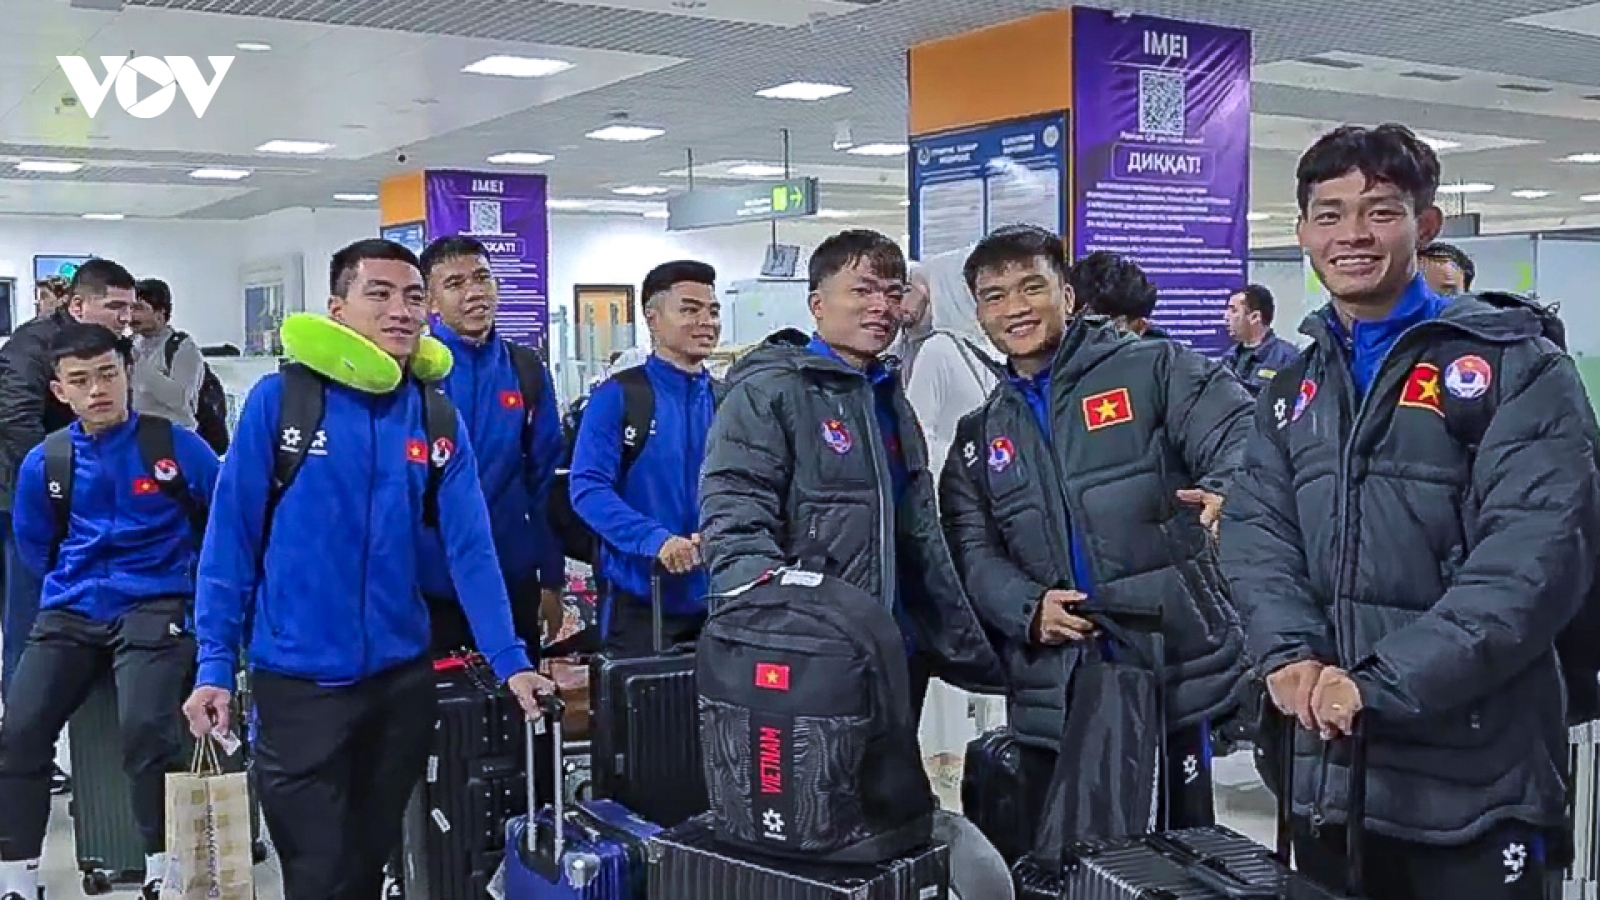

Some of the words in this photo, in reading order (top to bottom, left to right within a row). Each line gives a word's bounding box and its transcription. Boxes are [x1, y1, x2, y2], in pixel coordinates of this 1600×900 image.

[1143, 30, 1188, 59] IMEI
[472, 180, 504, 194] IMEI
[759, 726, 782, 794] VIETNAM
